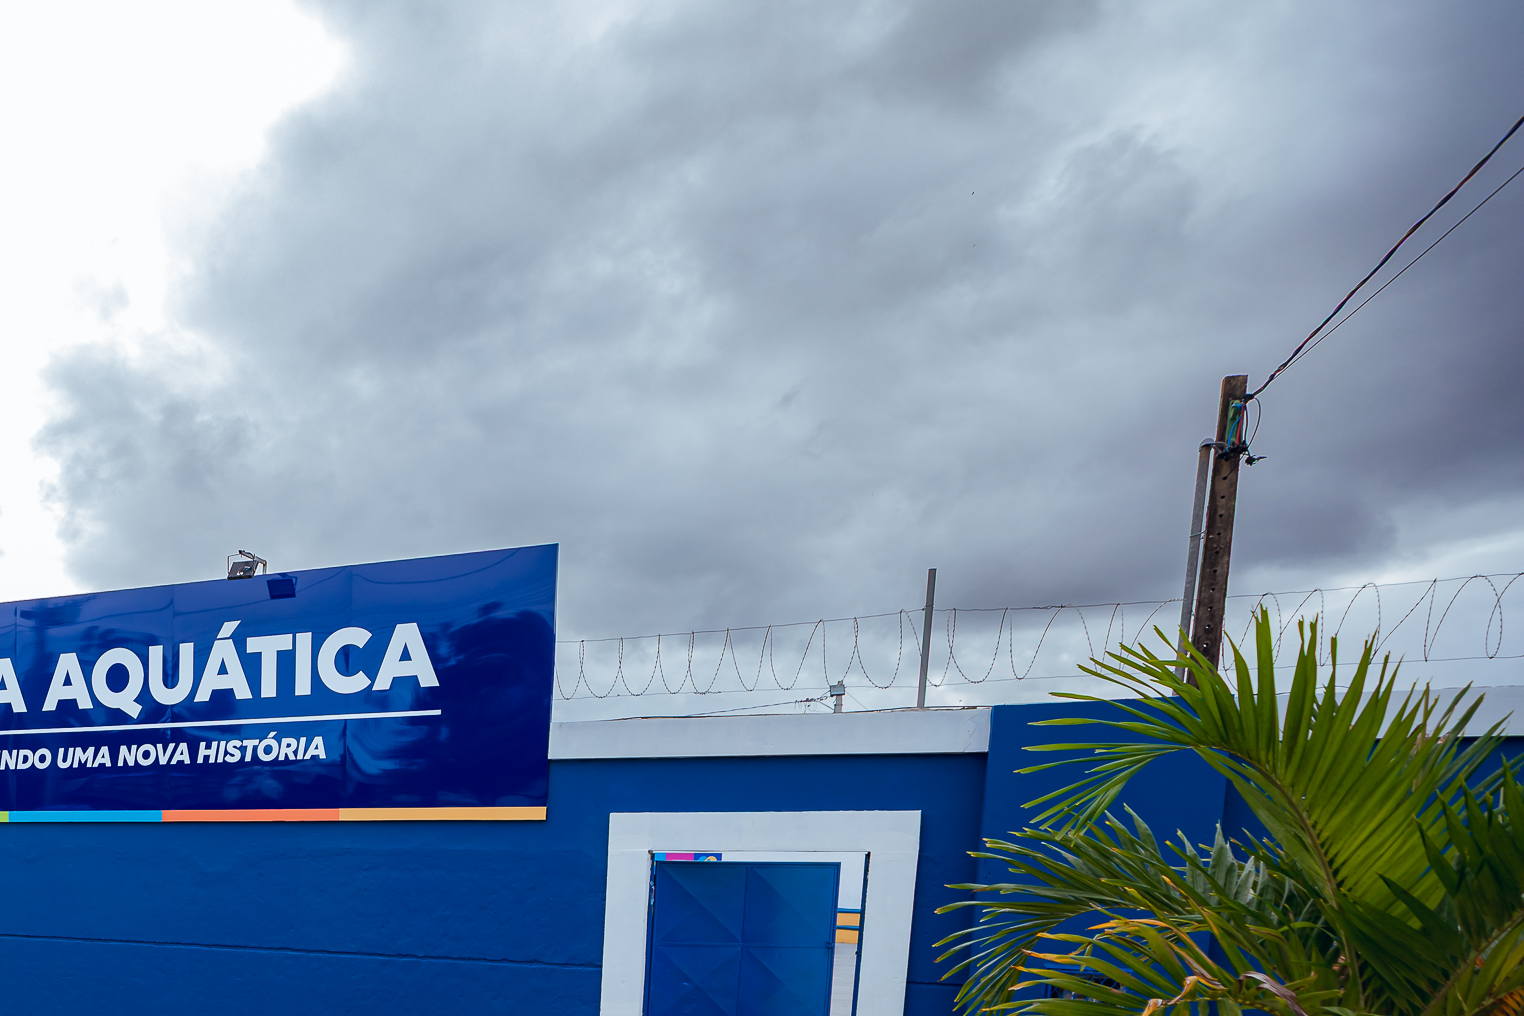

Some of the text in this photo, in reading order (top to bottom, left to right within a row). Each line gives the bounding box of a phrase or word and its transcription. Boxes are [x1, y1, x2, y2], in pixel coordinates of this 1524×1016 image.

[41, 619, 440, 720] AQUÁTICA
[57, 745, 112, 769] UMA
[117, 741, 191, 767] NOVA
[196, 731, 327, 764] HISTÓRIA
